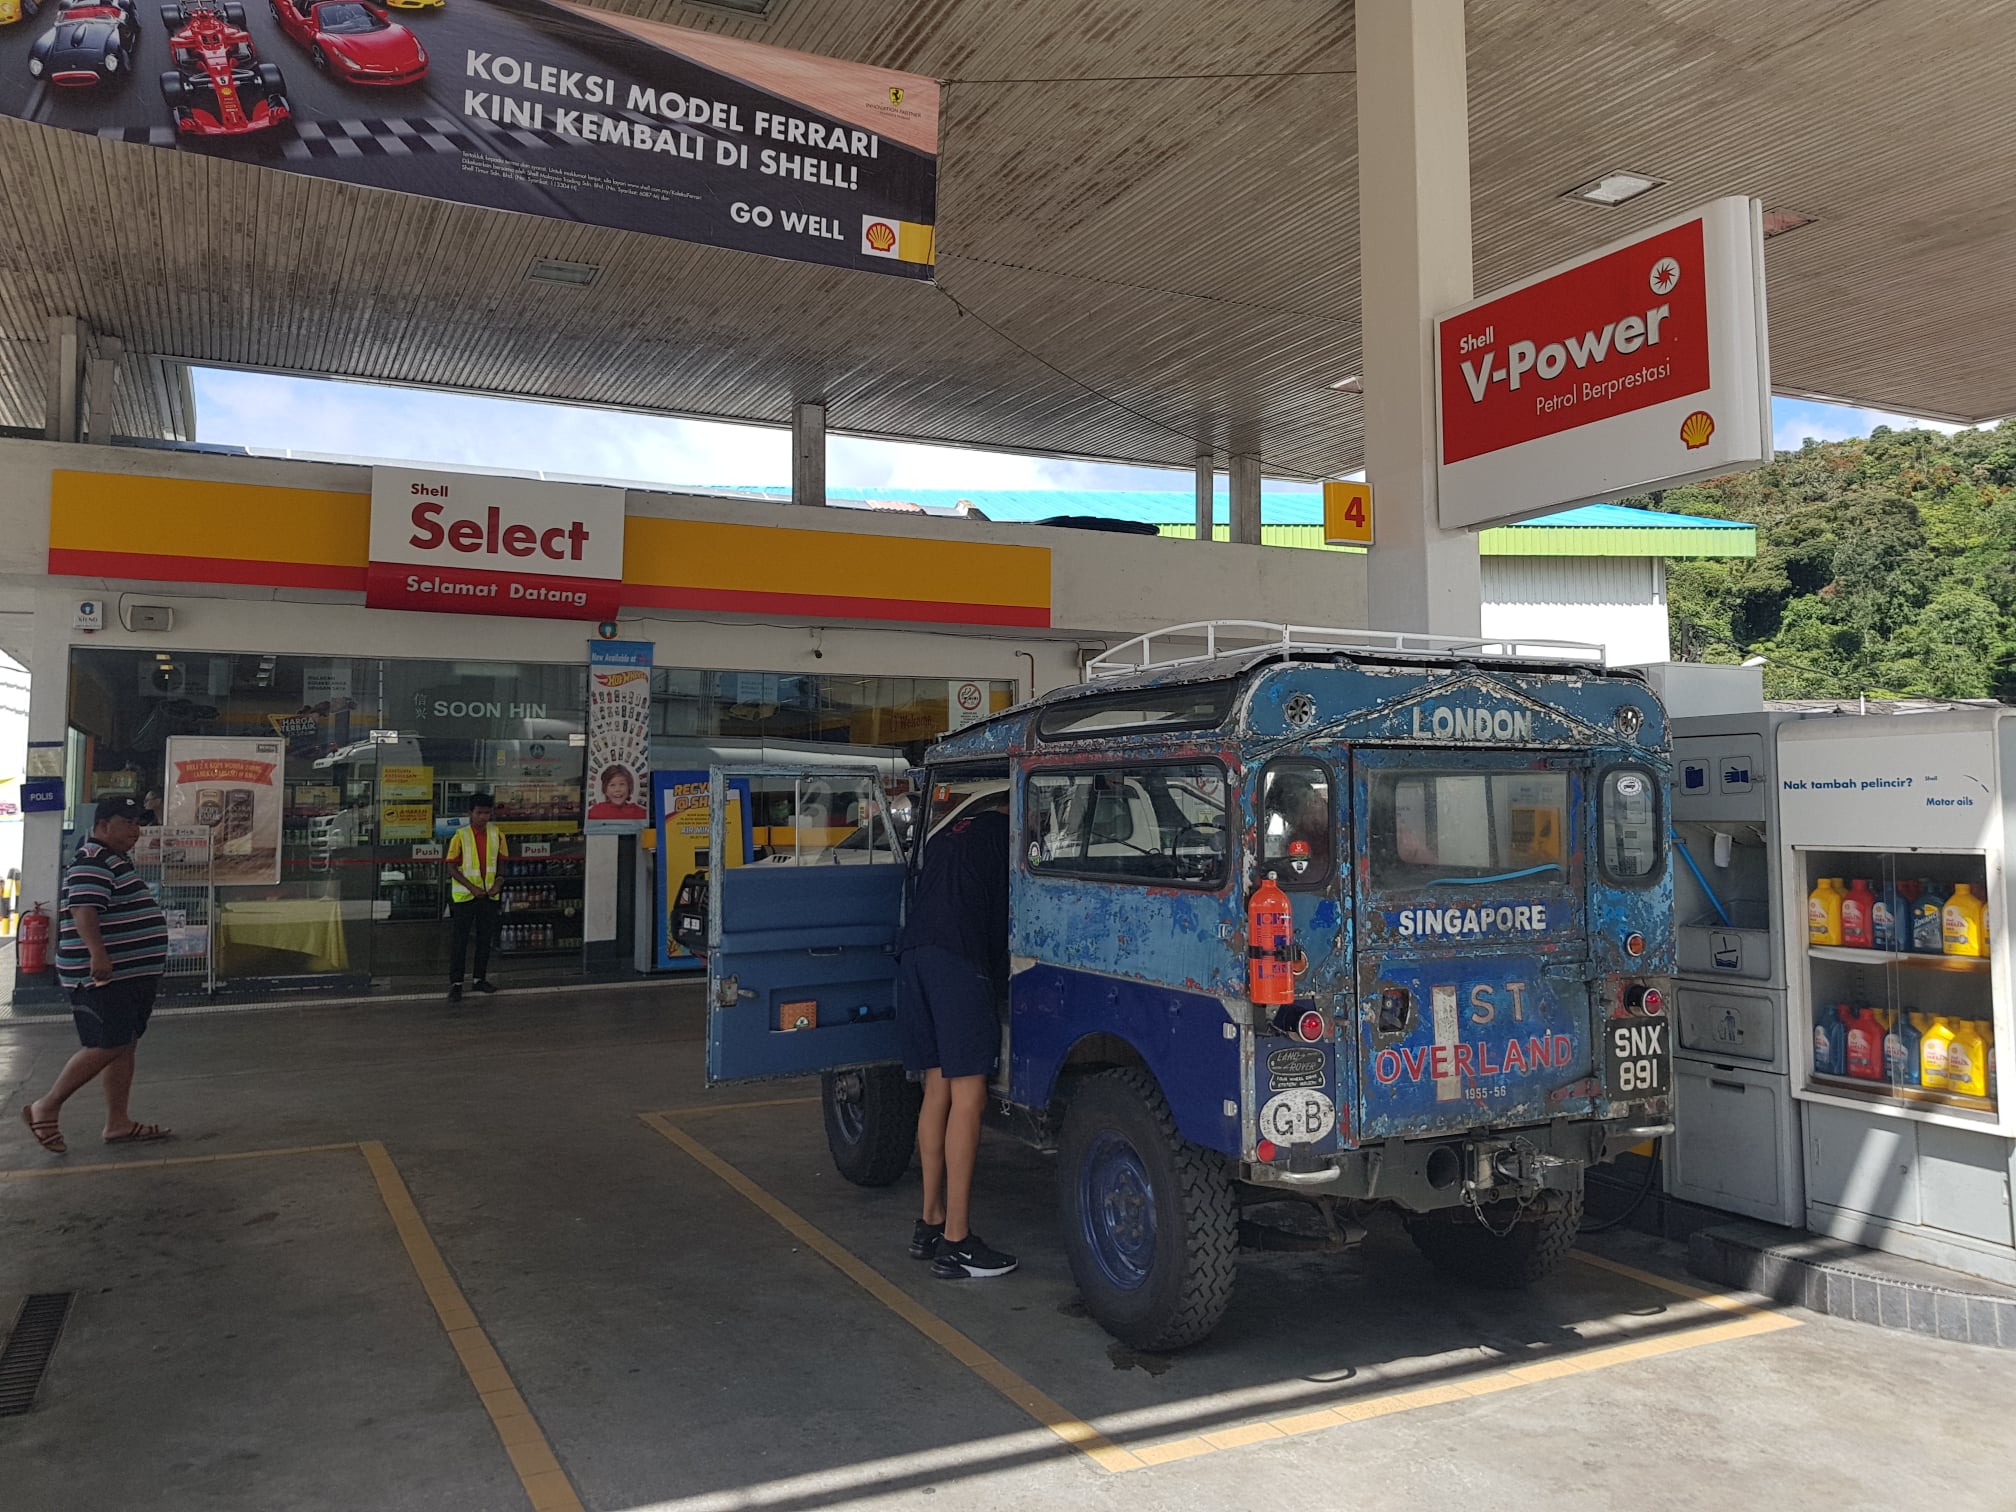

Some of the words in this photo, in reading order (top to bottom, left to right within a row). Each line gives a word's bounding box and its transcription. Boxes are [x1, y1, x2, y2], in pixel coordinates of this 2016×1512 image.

[466, 49, 614, 105] KOLEKSI
[626, 84, 744, 132] MODEL
[754, 110, 879, 159] FERRARI
[464, 89, 543, 129] KINI
[556, 108, 704, 160] KEMBALI
[716, 140, 748, 169] DI
[760, 149, 858, 190] SHELL!
[730, 201, 773, 227] GO
[780, 210, 845, 240] WELL
[1460, 325, 1494, 354] Shell
[1460, 303, 1670, 403] V-Power
[1536, 384, 1577, 415] Petrol
[1583, 357, 1670, 399] Berprestasi
[411, 483, 449, 497] Shell
[1344, 496, 1365, 528] 4
[409, 502, 589, 561] Select
[406, 575, 498, 597] Selamat
[509, 583, 587, 606] Datang
[282, 717, 315, 725] HARGA
[433, 701, 501, 717] SOON
[510, 702, 547, 718] HIN
[1412, 706, 1533, 741] LONDON
[30, 792, 54, 801] POLIS
[1784, 780, 1808, 790] Nak
[1811, 779, 1857, 789] tambah
[1861, 777, 1913, 791] pelincir?
[1926, 797, 1955, 806] Motor
[1957, 796, 1973, 806] oils
[415, 847, 440, 856] Push
[524, 844, 548, 854] Push
[1398, 905, 1547, 936] SINGAPORE
[1277, 1052, 1299, 1062] LAND
[1614, 1025, 1662, 1059] SNX
[1290, 1062, 1316, 1072] ROVER
[1375, 1034, 1572, 1084] OVERLAND
[1619, 1059, 1659, 1091] 891
[1465, 1086, 1507, 1100] 1955-56
